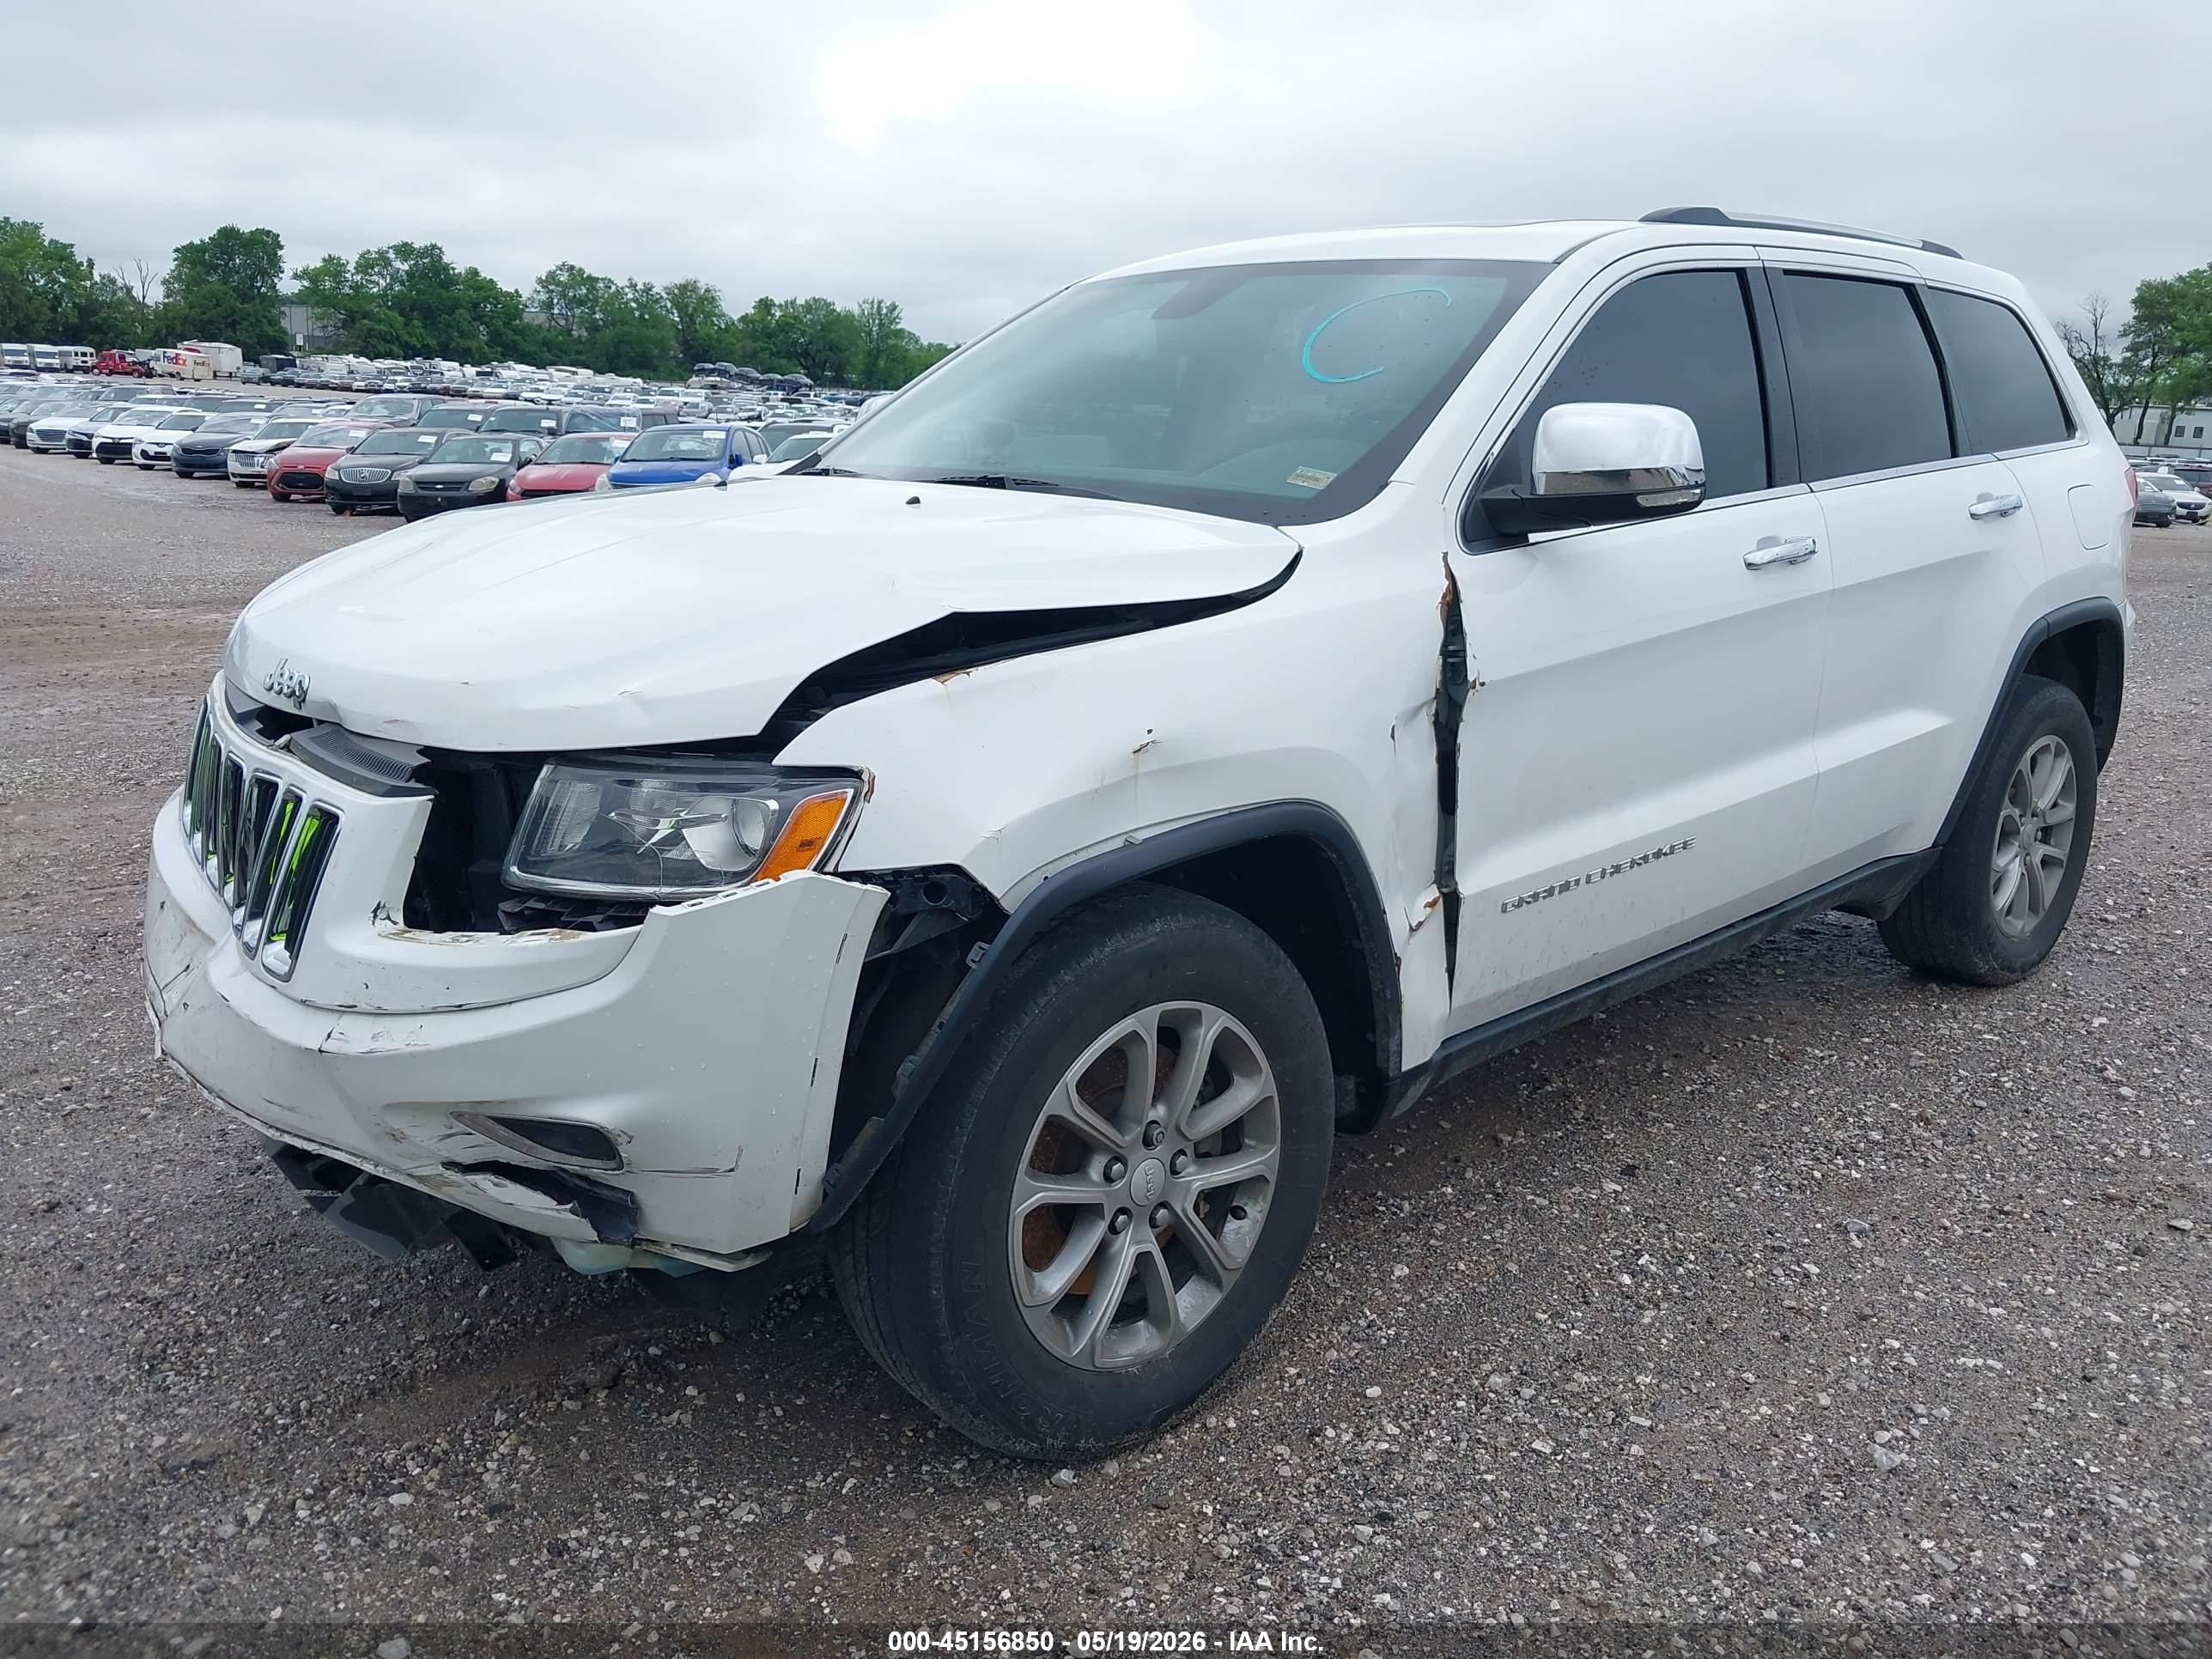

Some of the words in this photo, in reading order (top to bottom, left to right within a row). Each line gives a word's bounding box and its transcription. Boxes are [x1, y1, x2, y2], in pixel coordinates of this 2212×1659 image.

[163, 350, 187, 368] FedEx
[263, 658, 311, 709] Jeep
[1500, 875, 1582, 914] GRAND
[1585, 835, 1698, 885] CHEROKEE
[1144, 1165, 1156, 1201] Jeep
